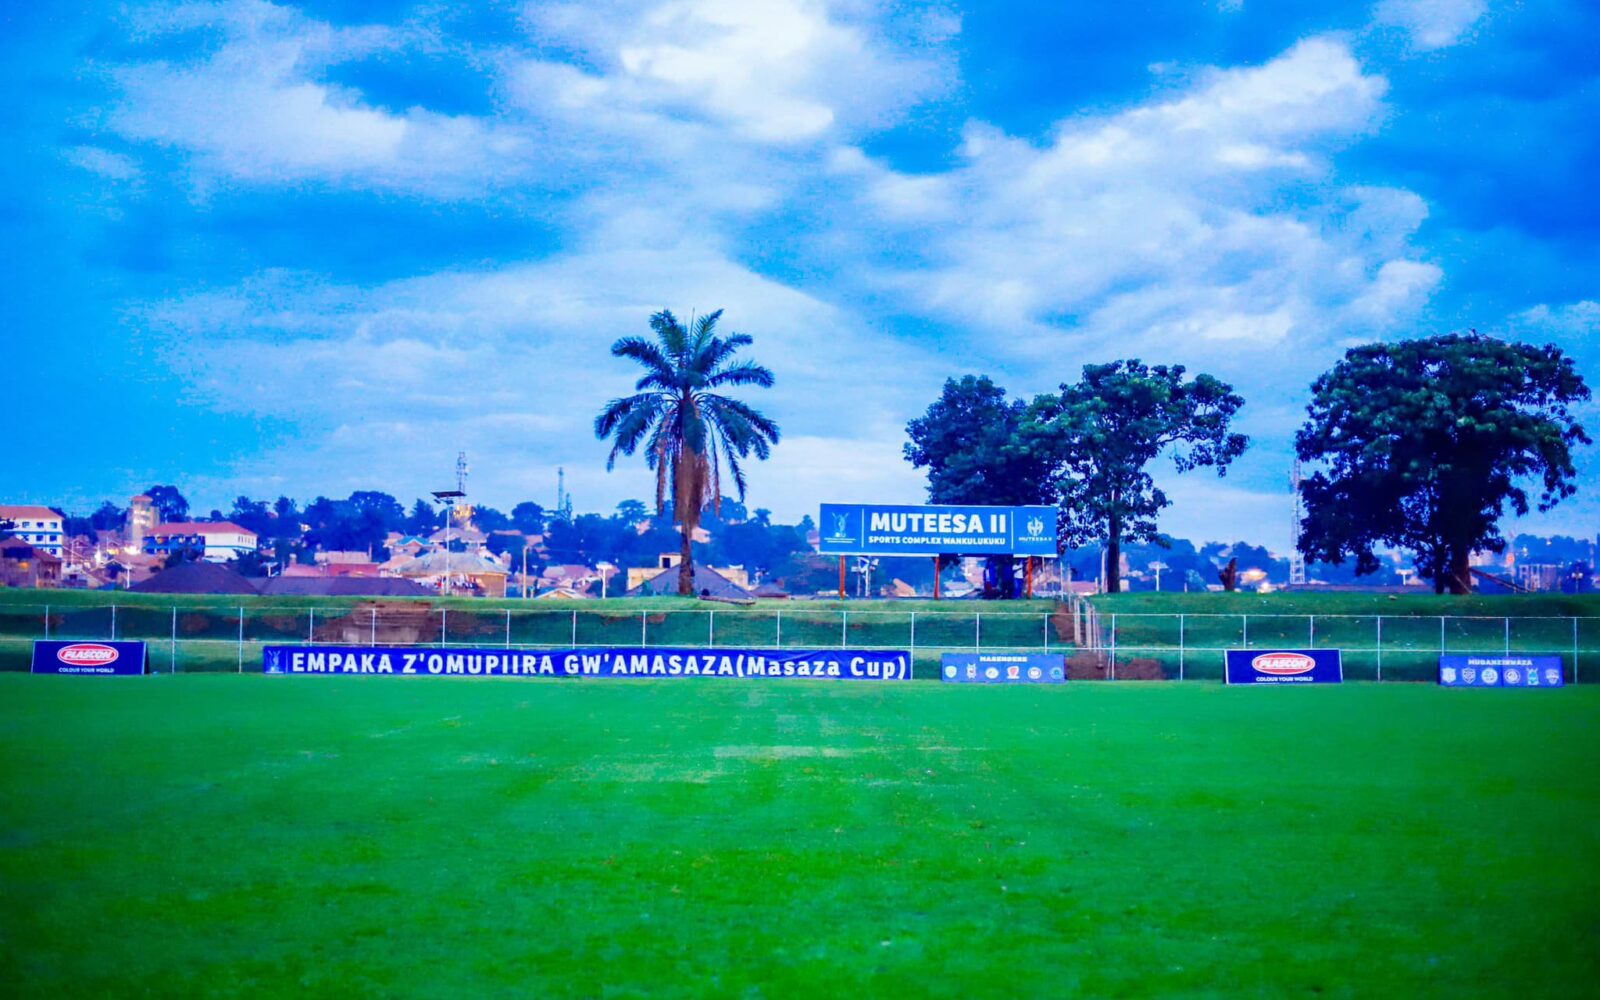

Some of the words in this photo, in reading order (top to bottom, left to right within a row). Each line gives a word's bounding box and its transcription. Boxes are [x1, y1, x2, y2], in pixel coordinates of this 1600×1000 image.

[870, 512, 984, 533] MUTEESA
[990, 514, 1006, 533] II
[868, 536, 901, 544] SPORTS
[902, 536, 941, 545] COMPLEX
[943, 537, 1006, 545] WANKULUKUKU
[63, 650, 111, 660] PLASCON
[292, 652, 393, 673] EMPAKA
[402, 654, 555, 674] Z'OMUPIIRA
[850, 655, 906, 679] Cup)
[1259, 659, 1307, 669] PLASCON
